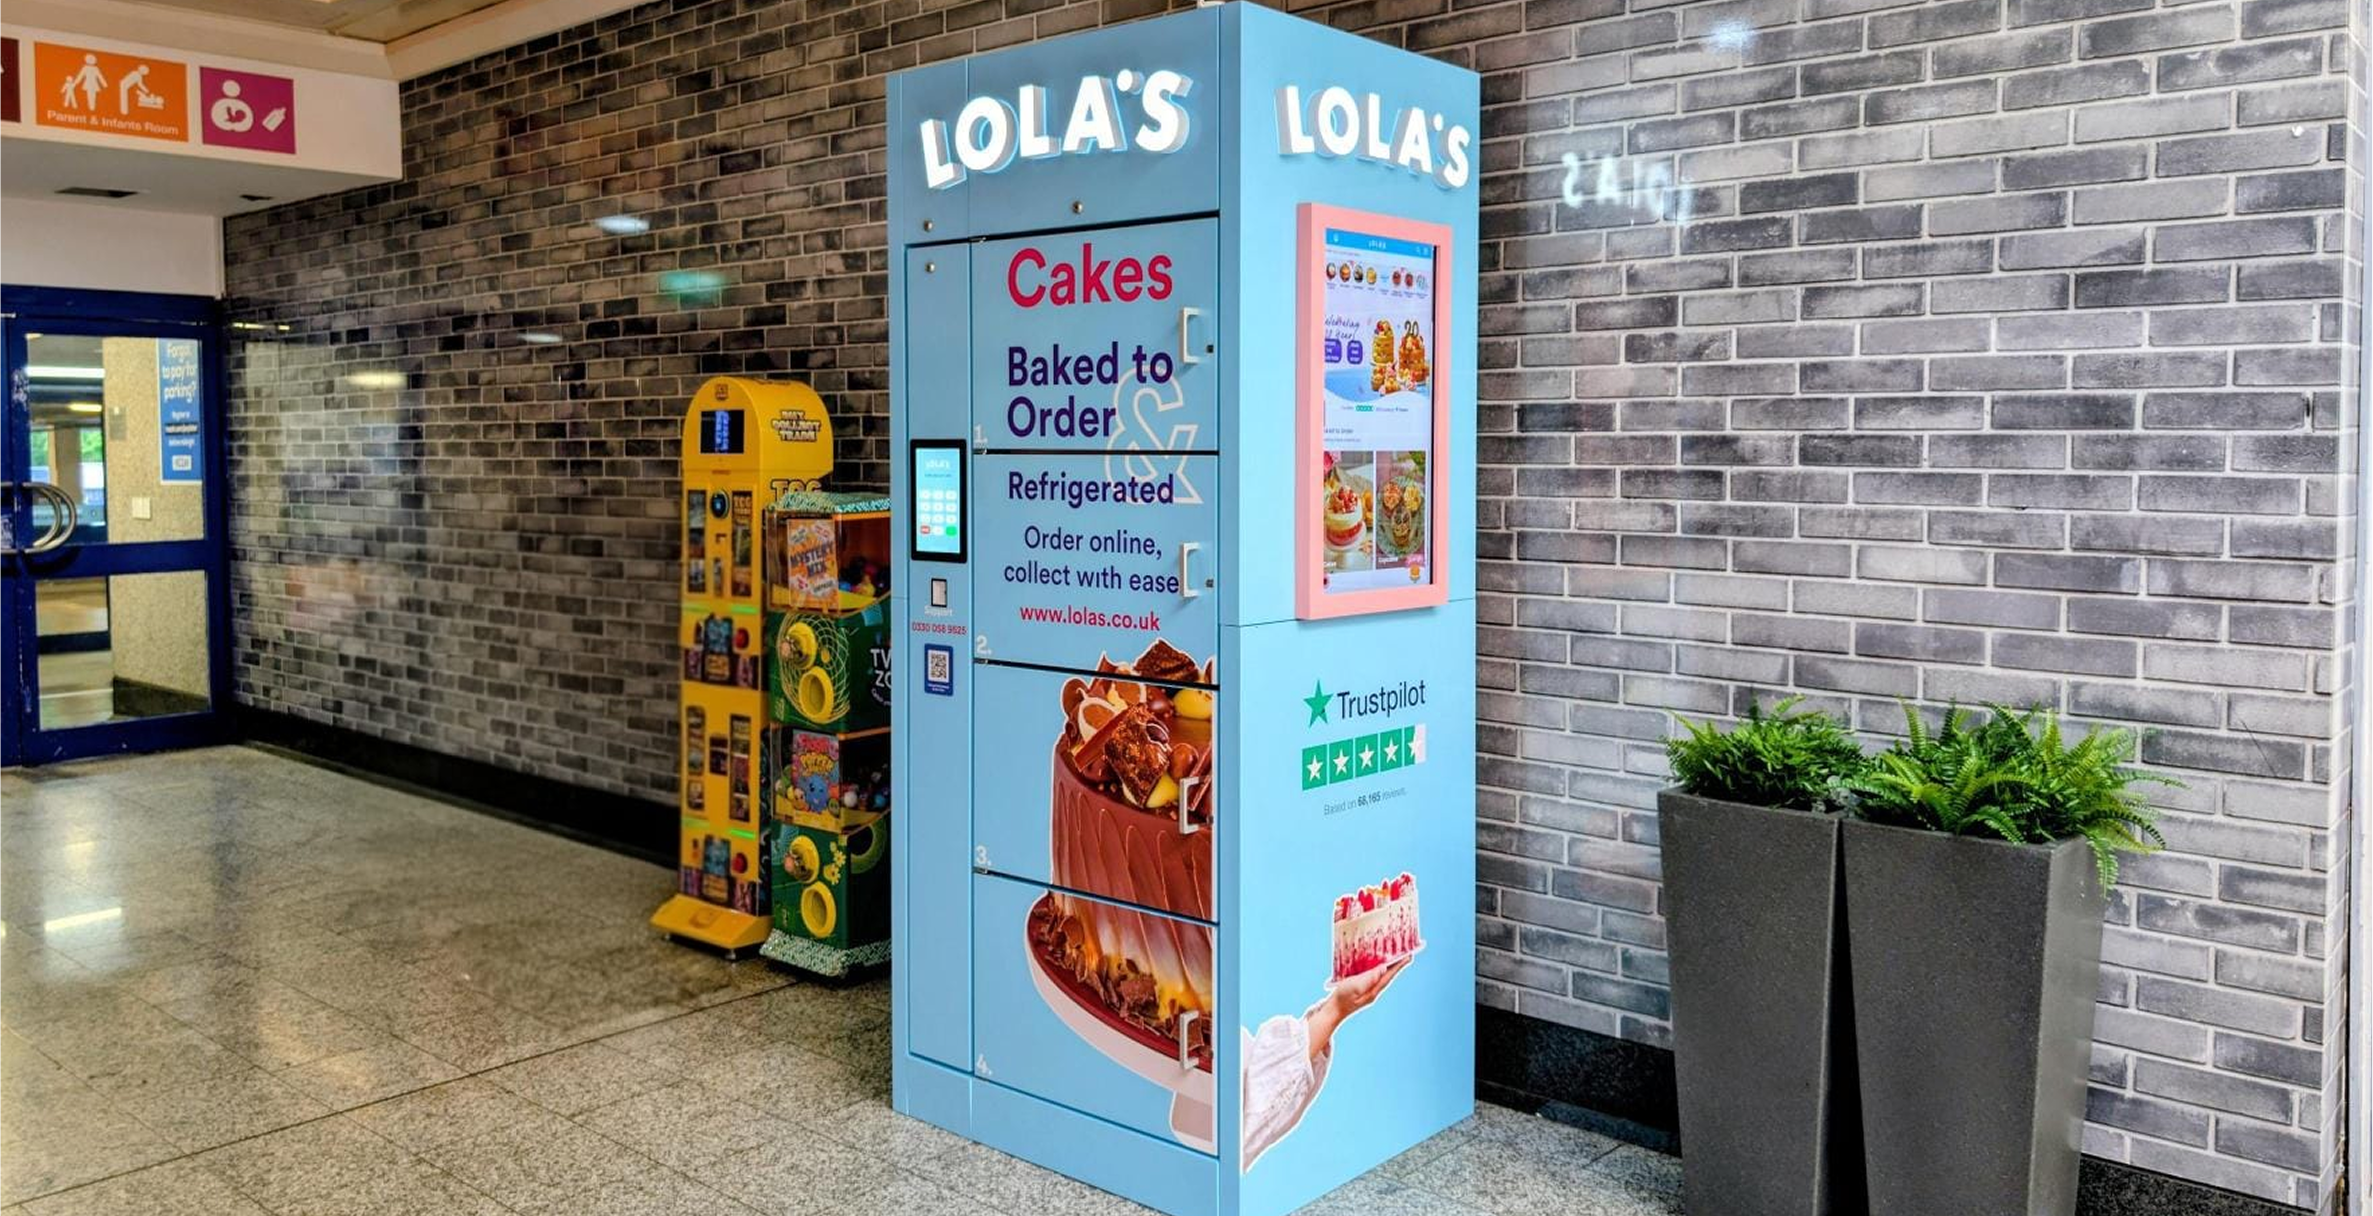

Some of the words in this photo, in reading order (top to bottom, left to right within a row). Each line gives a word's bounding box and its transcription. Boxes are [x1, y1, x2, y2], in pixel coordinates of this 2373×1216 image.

[47, 110, 87, 123] Parent
[89, 115, 99, 125] &
[102, 117, 142, 131] Infants
[144, 121, 179, 135] Room
[920, 69, 1193, 190] LOLA'S
[1275, 84, 1471, 189] LOLA'S
[1008, 242, 1172, 308] Cakes
[1009, 341, 1118, 386] Baked
[1132, 345, 1173, 384] to
[1008, 395, 1116, 438] Order
[1008, 471, 1174, 509] Refrigerated
[1024, 525, 1083, 551] Order
[1089, 529, 1162, 562] online,
[1004, 561, 1070, 586] collect
[1076, 566, 1122, 589] with
[1129, 573, 1179, 593] ease
[1020, 605, 1160, 631] www.lolas.co.uk
[1337, 680, 1426, 720] Trustpilot
[976, 846, 992, 866] 3.
